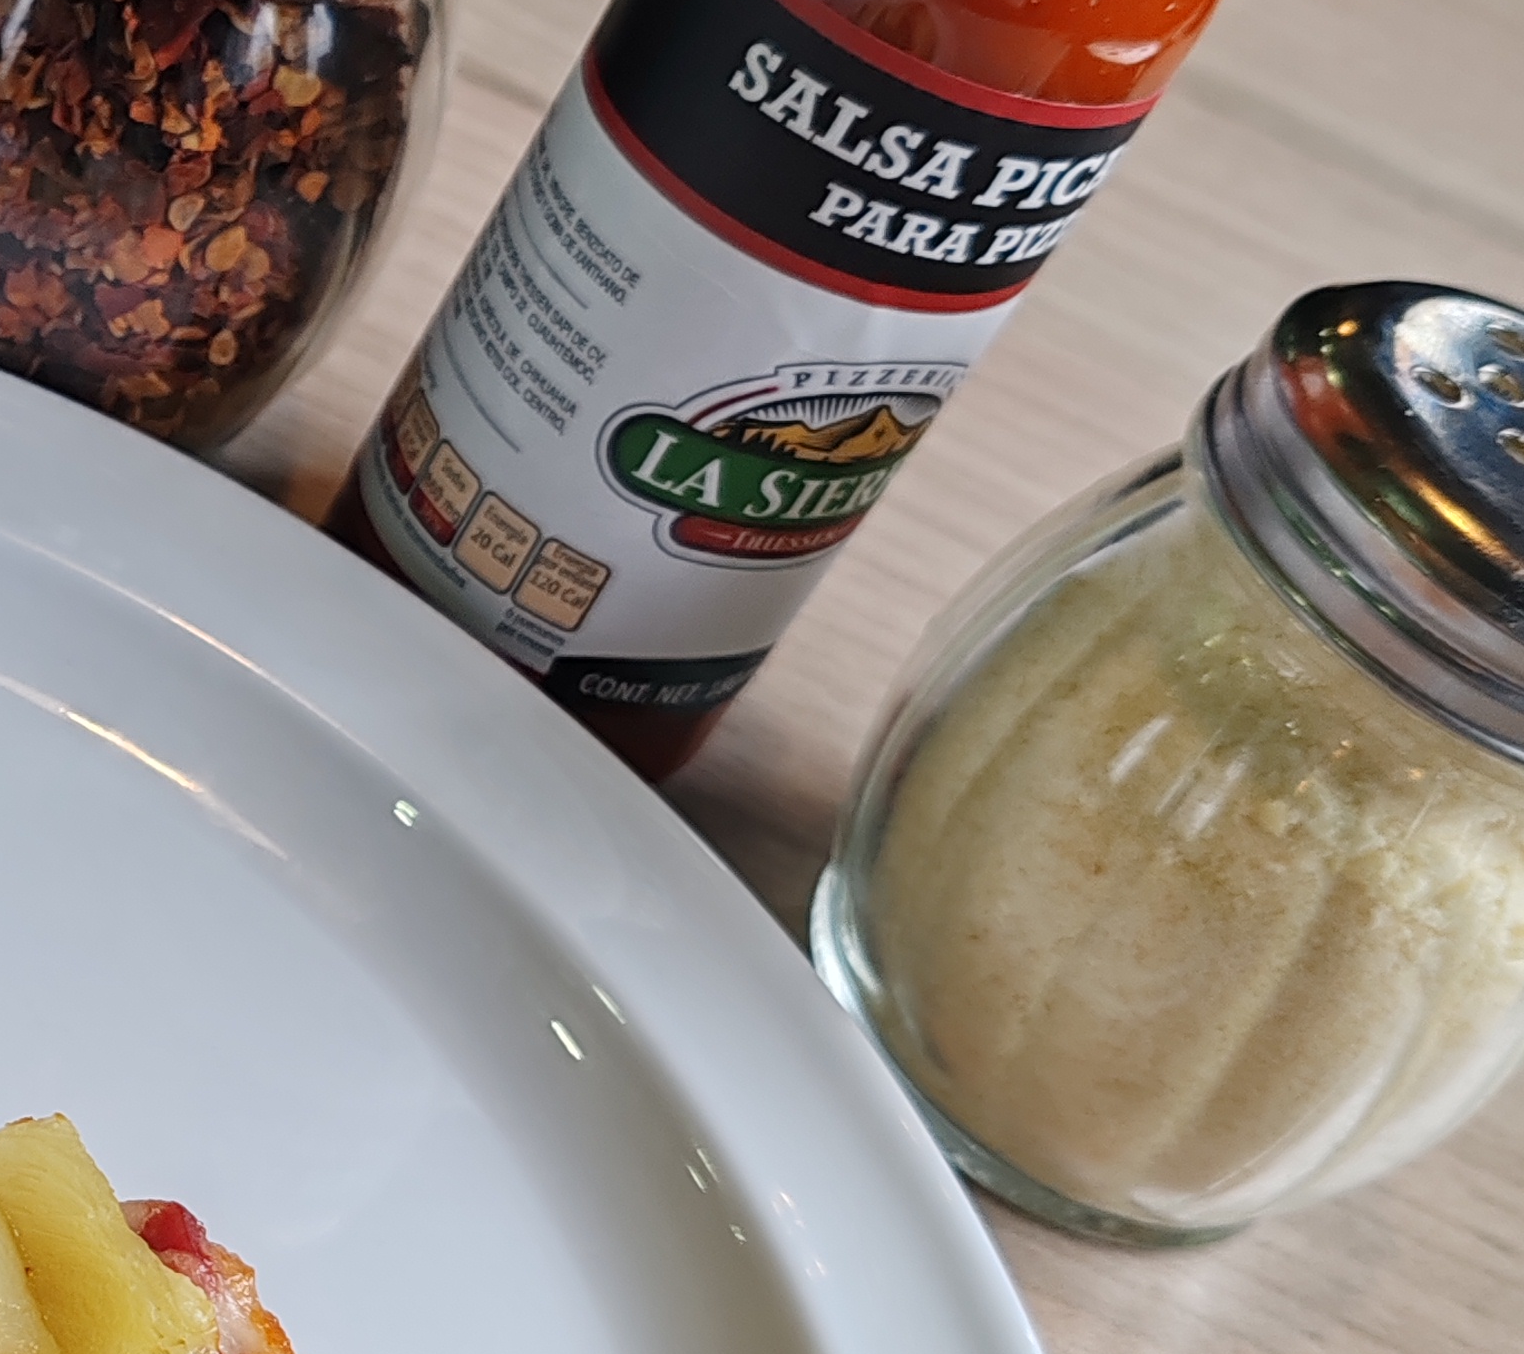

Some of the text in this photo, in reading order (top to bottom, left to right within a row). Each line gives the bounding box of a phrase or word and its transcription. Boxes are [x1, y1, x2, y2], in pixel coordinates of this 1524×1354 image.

[728, 42, 979, 201] SALSA
[807, 181, 980, 265] PARA
[630, 428, 891, 520] LA SIER
